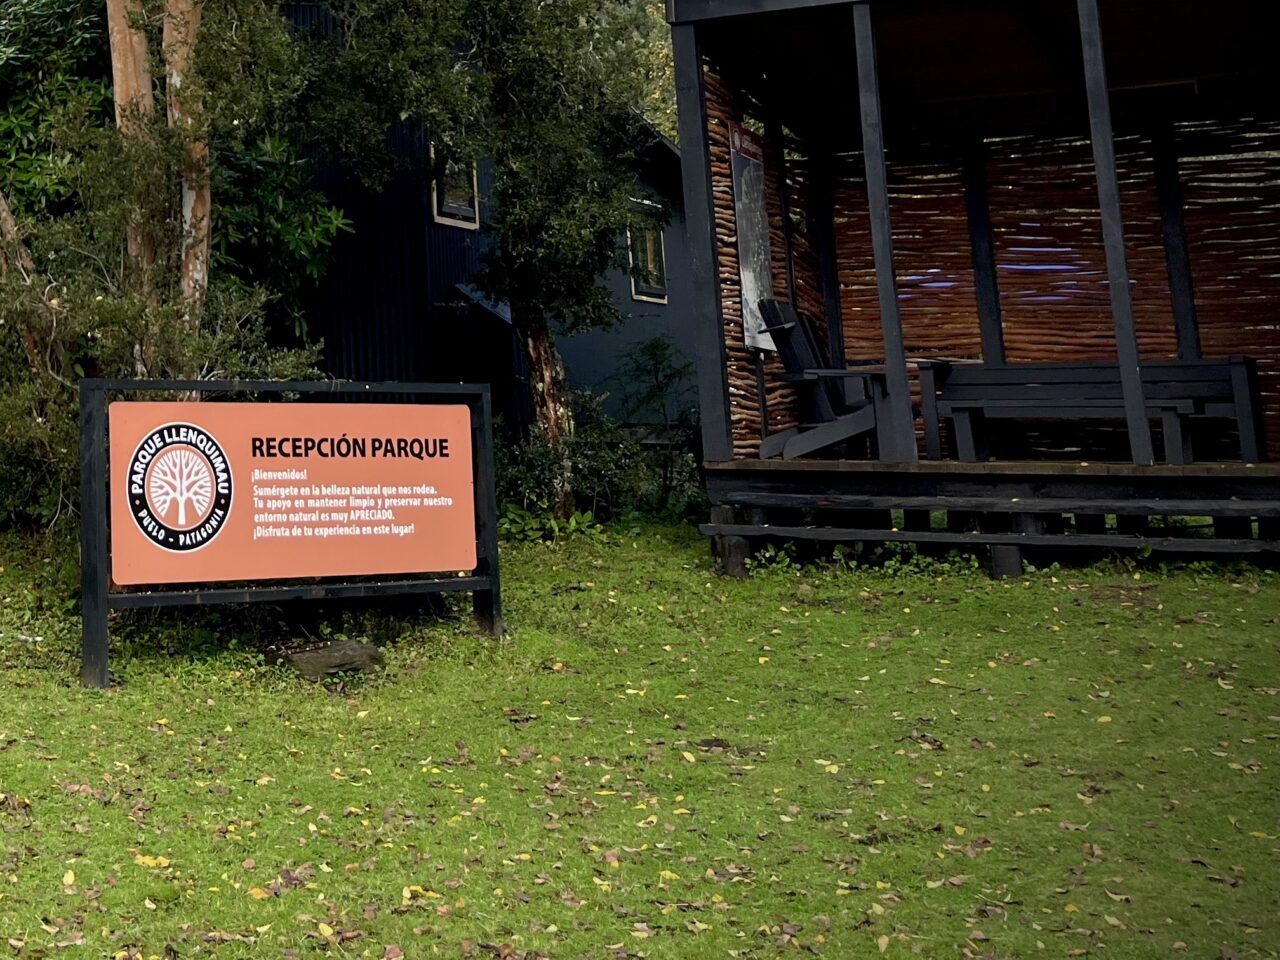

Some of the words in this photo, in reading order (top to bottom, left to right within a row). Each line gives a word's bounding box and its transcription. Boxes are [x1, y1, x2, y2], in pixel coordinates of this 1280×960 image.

[251, 433, 366, 458] RECEPCIÓN
[371, 438, 450, 460] PARQUE
[131, 433, 164, 494] PARQUE
[163, 428, 229, 494] LLENQUIMAU
[251, 468, 307, 483] ¡Bienvenidos!
[253, 484, 298, 498] Sumérgete
[300, 487, 310, 496] en
[312, 484, 320, 495] la
[321, 484, 350, 495] belleza
[351, 484, 381, 495] natural
[382, 486, 397, 497] que
[398, 486, 412, 494] nos
[413, 483, 438, 494] rodea.
[253, 497, 264, 508] Tu
[266, 499, 292, 511] apoyo
[294, 499, 305, 508] en
[307, 497, 347, 508] mantener
[349, 496, 375, 509] limpio
[377, 498, 383, 508] y
[384, 497, 421, 509] preservar
[423, 496, 453, 506] nuestro
[254, 511, 288, 522] entorno
[289, 510, 319, 521] natural
[320, 512, 329, 521] es
[331, 511, 348, 523] muy
[350, 509, 395, 521] APRECIADO.
[138, 509, 166, 540] PUELO
[179, 508, 224, 546] PATAGONIA
[253, 525, 290, 540] ¡Disfruta
[291, 524, 302, 536] de
[303, 526, 313, 536] tu
[314, 524, 360, 538] experiencia
[362, 526, 372, 535] en
[373, 524, 390, 535] este
[391, 523, 415, 537] lugar!
